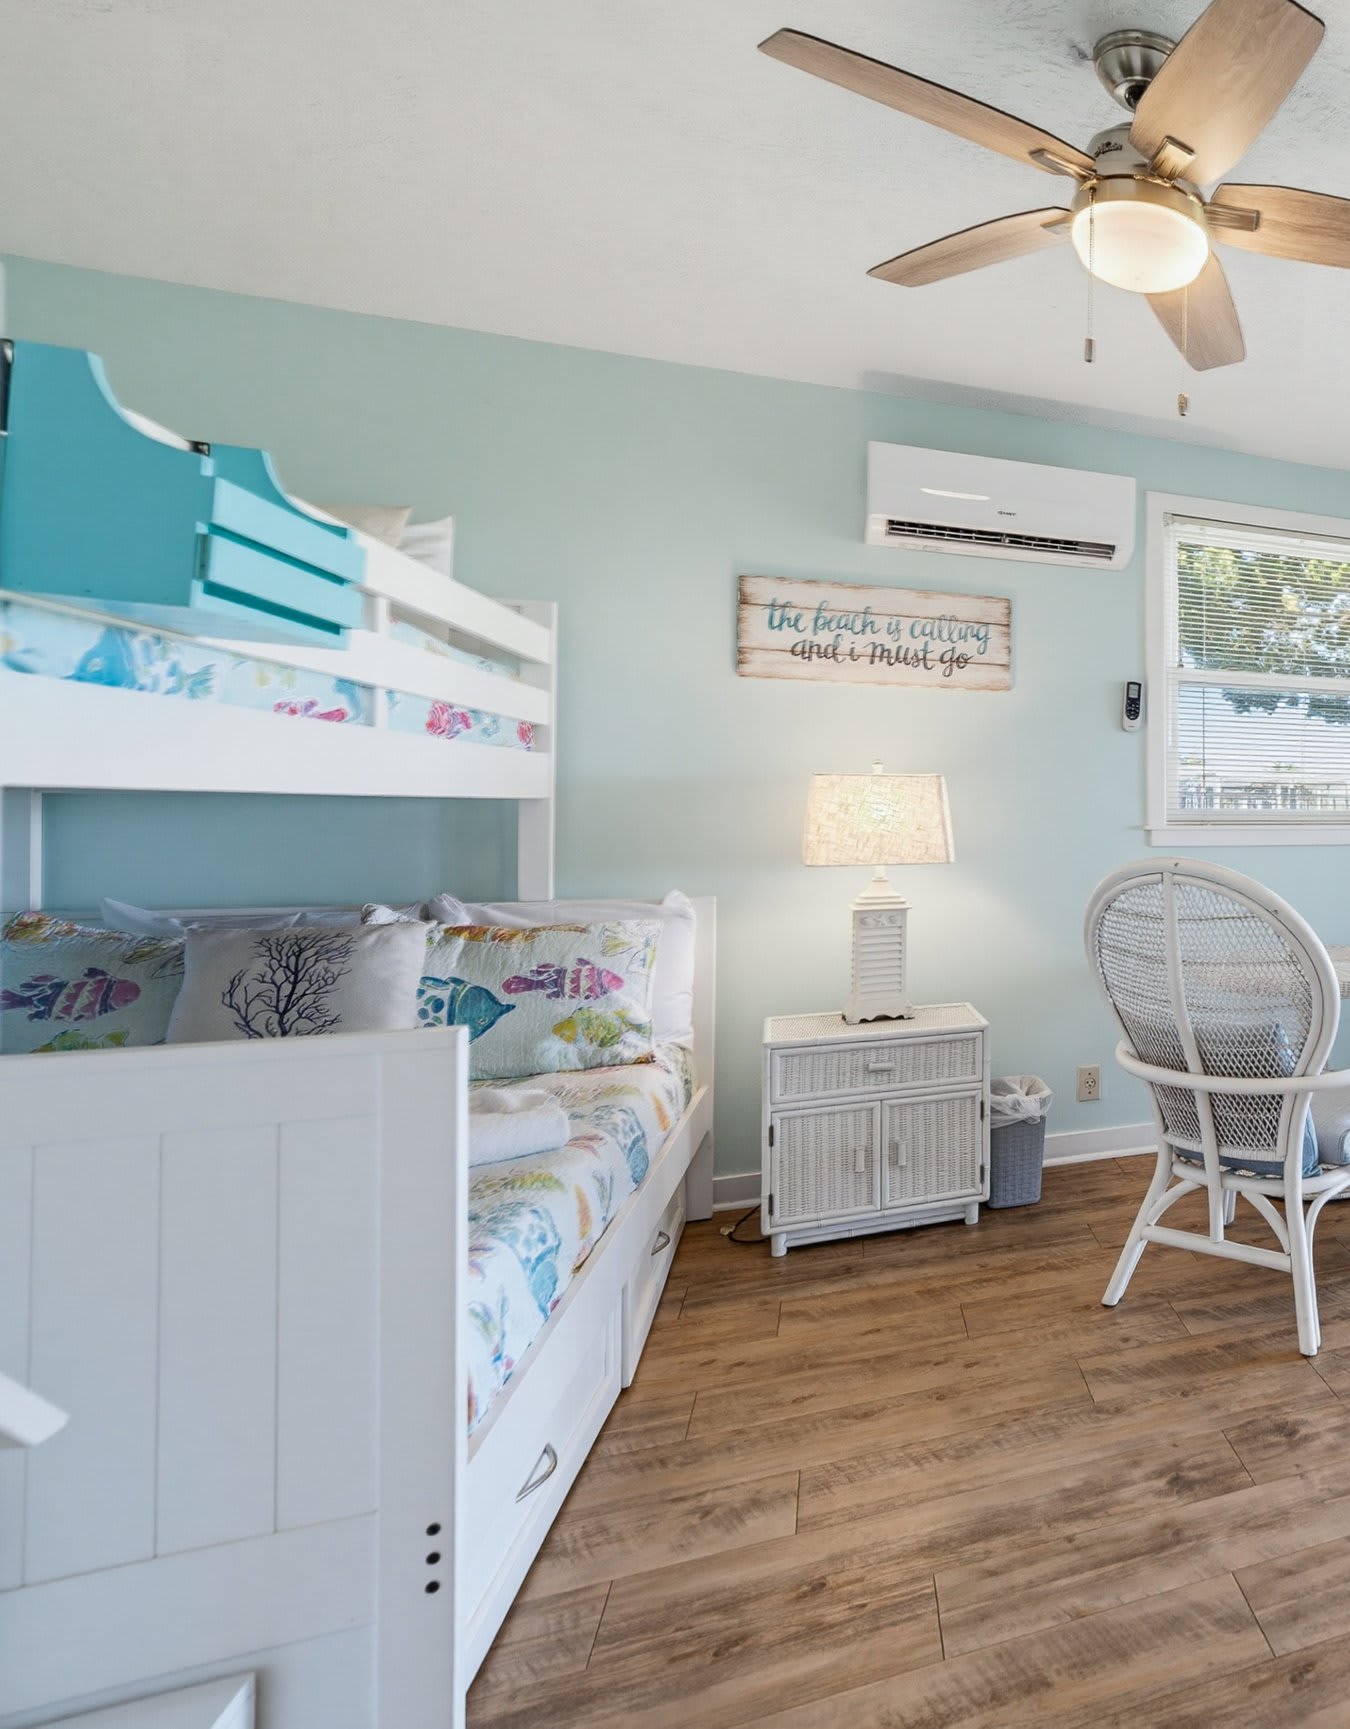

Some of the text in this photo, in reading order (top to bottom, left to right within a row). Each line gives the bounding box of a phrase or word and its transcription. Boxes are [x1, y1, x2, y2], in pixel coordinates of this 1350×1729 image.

[761, 598, 991, 655] the beach is calling
[791, 634, 974, 677] and i must go
